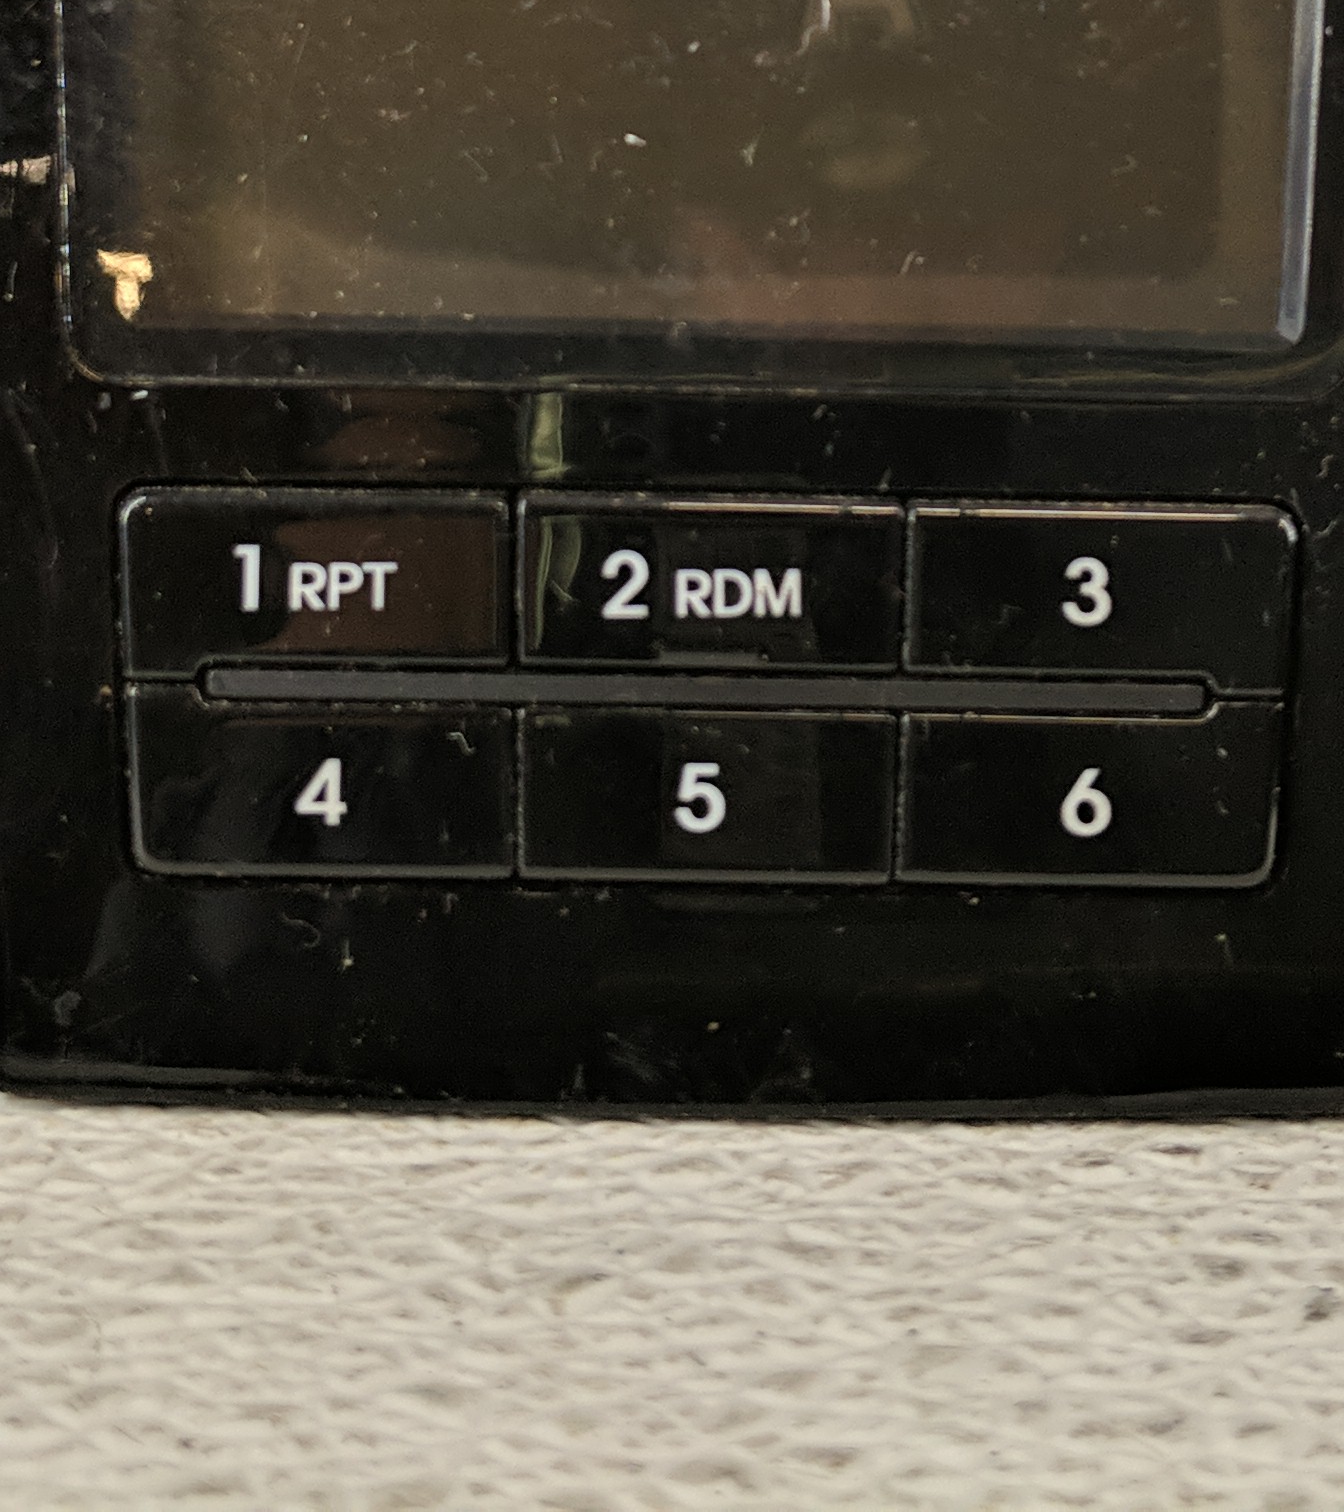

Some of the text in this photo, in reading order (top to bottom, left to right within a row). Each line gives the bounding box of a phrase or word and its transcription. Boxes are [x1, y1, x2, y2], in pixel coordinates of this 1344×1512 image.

[232, 542, 398, 612] 1 RPT
[601, 548, 803, 620] 2 RDM
[1060, 555, 1112, 627] 3
[294, 756, 348, 827] 4
[673, 761, 726, 834] 5
[1060, 766, 1112, 838] 6
